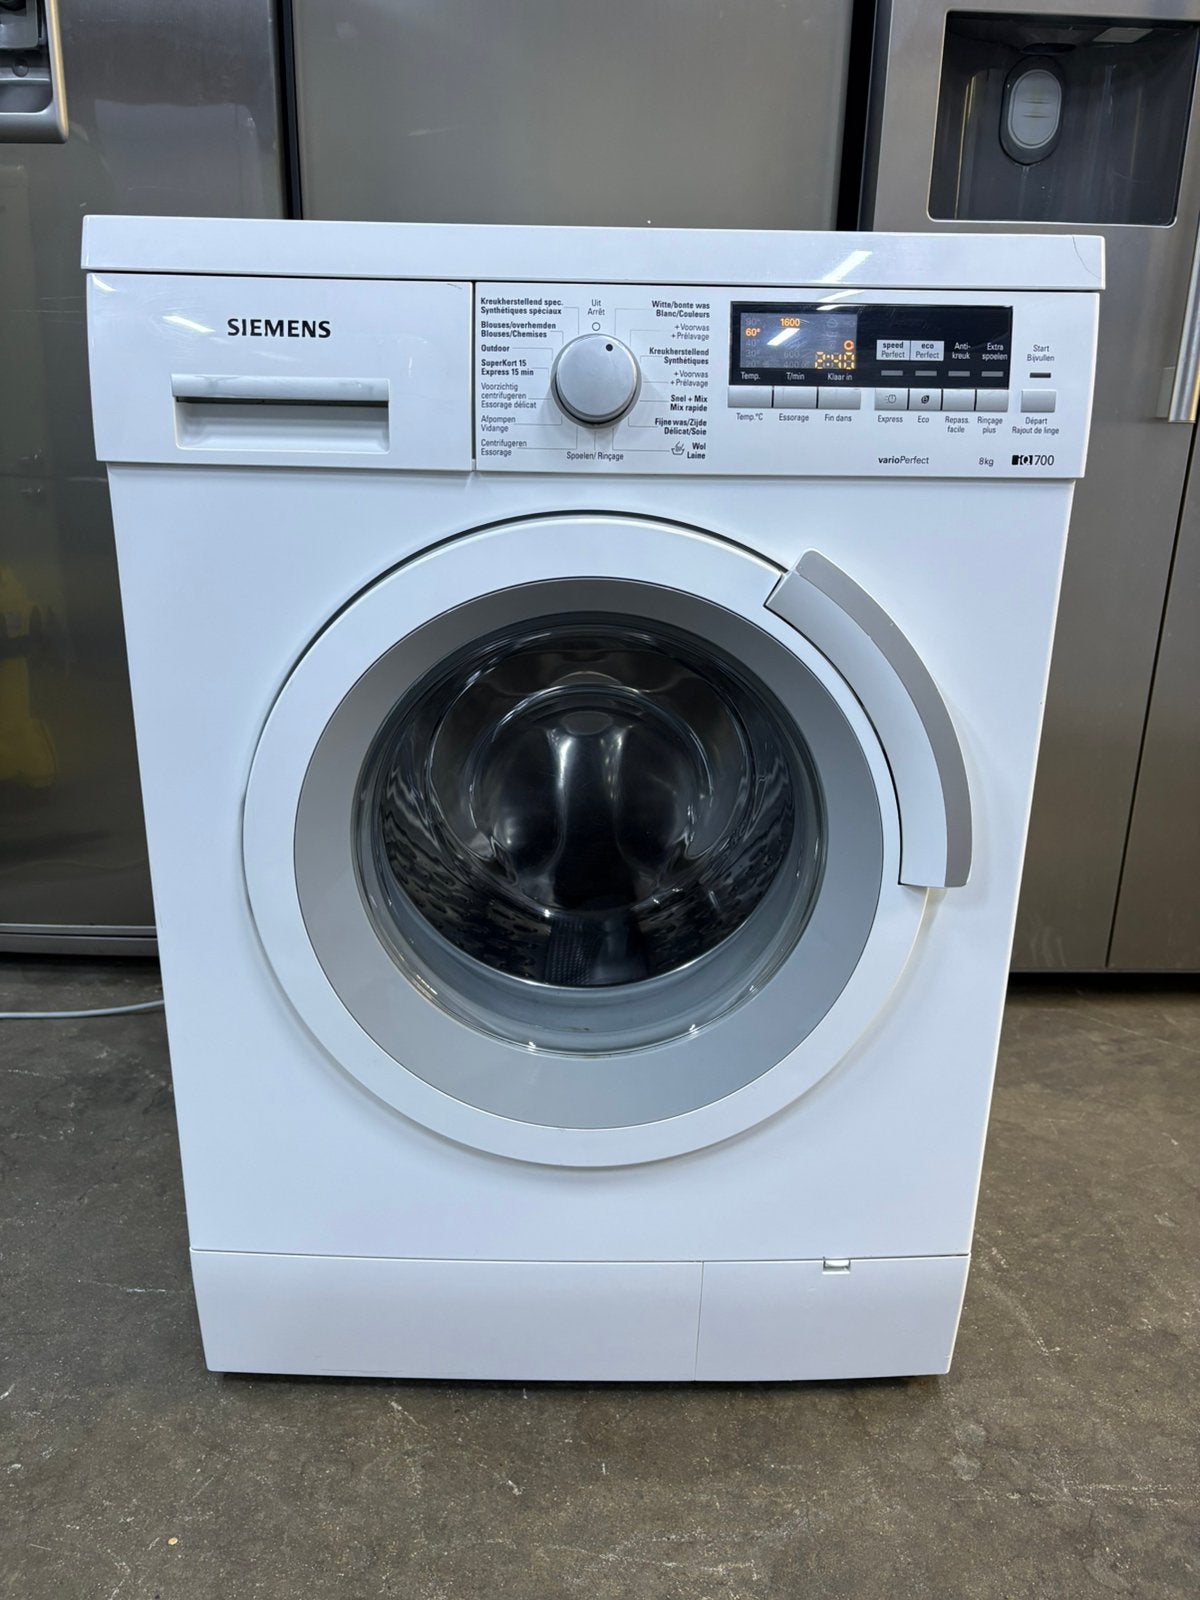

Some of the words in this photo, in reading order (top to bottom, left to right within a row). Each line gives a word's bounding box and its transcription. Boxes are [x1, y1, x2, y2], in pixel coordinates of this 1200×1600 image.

[652, 300, 693, 309] Witte/bonte
[481, 307, 527, 315] Synthétiques
[656, 310, 710, 318] Blanc/Couleurs
[481, 321, 556, 329] Blouses/overhemden
[780, 318, 800, 327] 1600
[228, 318, 331, 338] SIEMENS
[746, 328, 760, 336] 60°
[481, 330, 547, 338] Blouses/Chemises
[677, 332, 709, 341] Prélavage
[481, 344, 509, 352] Outdoor
[650, 347, 709, 355] Kreukherstellend
[987, 343, 1003, 351] Extra
[1033, 344, 1050, 352] Start
[664, 356, 709, 366] Synthétiques
[1027, 354, 1055, 362] Bijvullen
[481, 359, 517, 367] SuperKort
[481, 369, 509, 377] Express
[680, 370, 708, 378] Voorwas
[741, 372, 760, 380] Temp.
[786, 372, 805, 380] T/min
[481, 383, 518, 392] Voorzichtig
[676, 379, 708, 388] Prélavage
[481, 392, 526, 401] centrifugeren
[481, 401, 512, 410] Essorage
[686, 404, 707, 413] rapide
[481, 415, 515, 424] Afpompen
[779, 414, 809, 422] Essorage
[836, 414, 852, 422] dans
[878, 415, 903, 424] Express
[945, 416, 969, 424] Repass.
[978, 416, 1003, 426] Rinçage
[1025, 417, 1047, 426] Départ
[655, 418, 671, 427] Fijne
[673, 418, 707, 427] was/Zijde
[481, 425, 508, 433] Vidange
[664, 427, 706, 436] Délicat/Soie
[947, 425, 964, 433] facile
[982, 426, 996, 434] plus
[1012, 427, 1033, 435] Rajout
[1044, 427, 1059, 436] linge
[481, 439, 527, 448] Centrifugeren
[692, 442, 706, 450] Wol
[481, 449, 512, 457] Essorage
[598, 452, 624, 461] Rinçage
[687, 451, 705, 459] Laine
[878, 456, 929, 465] varioPerfect
